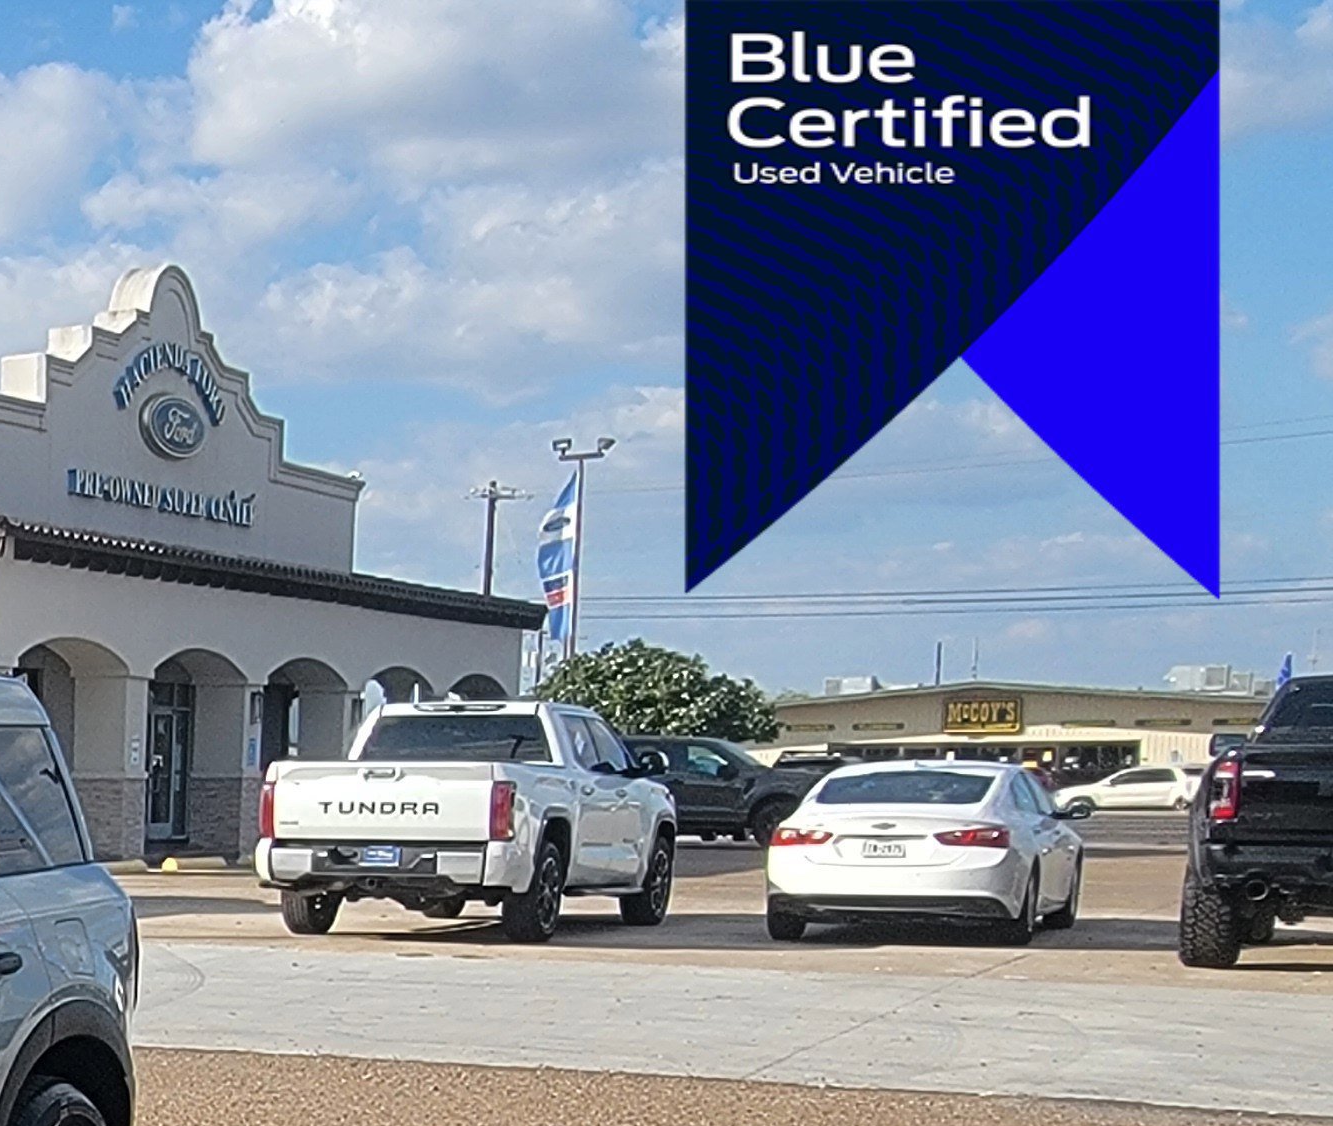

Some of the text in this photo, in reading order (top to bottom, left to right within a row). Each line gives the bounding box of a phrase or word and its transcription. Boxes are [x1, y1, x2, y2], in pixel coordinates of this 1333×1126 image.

[114, 341, 191, 410] HACIENDA
[164, 406, 198, 446] Ford
[69, 468, 161, 509] PRE-OWNED
[165, 486, 207, 519] SUPER
[318, 801, 440, 816] TUNDRA
